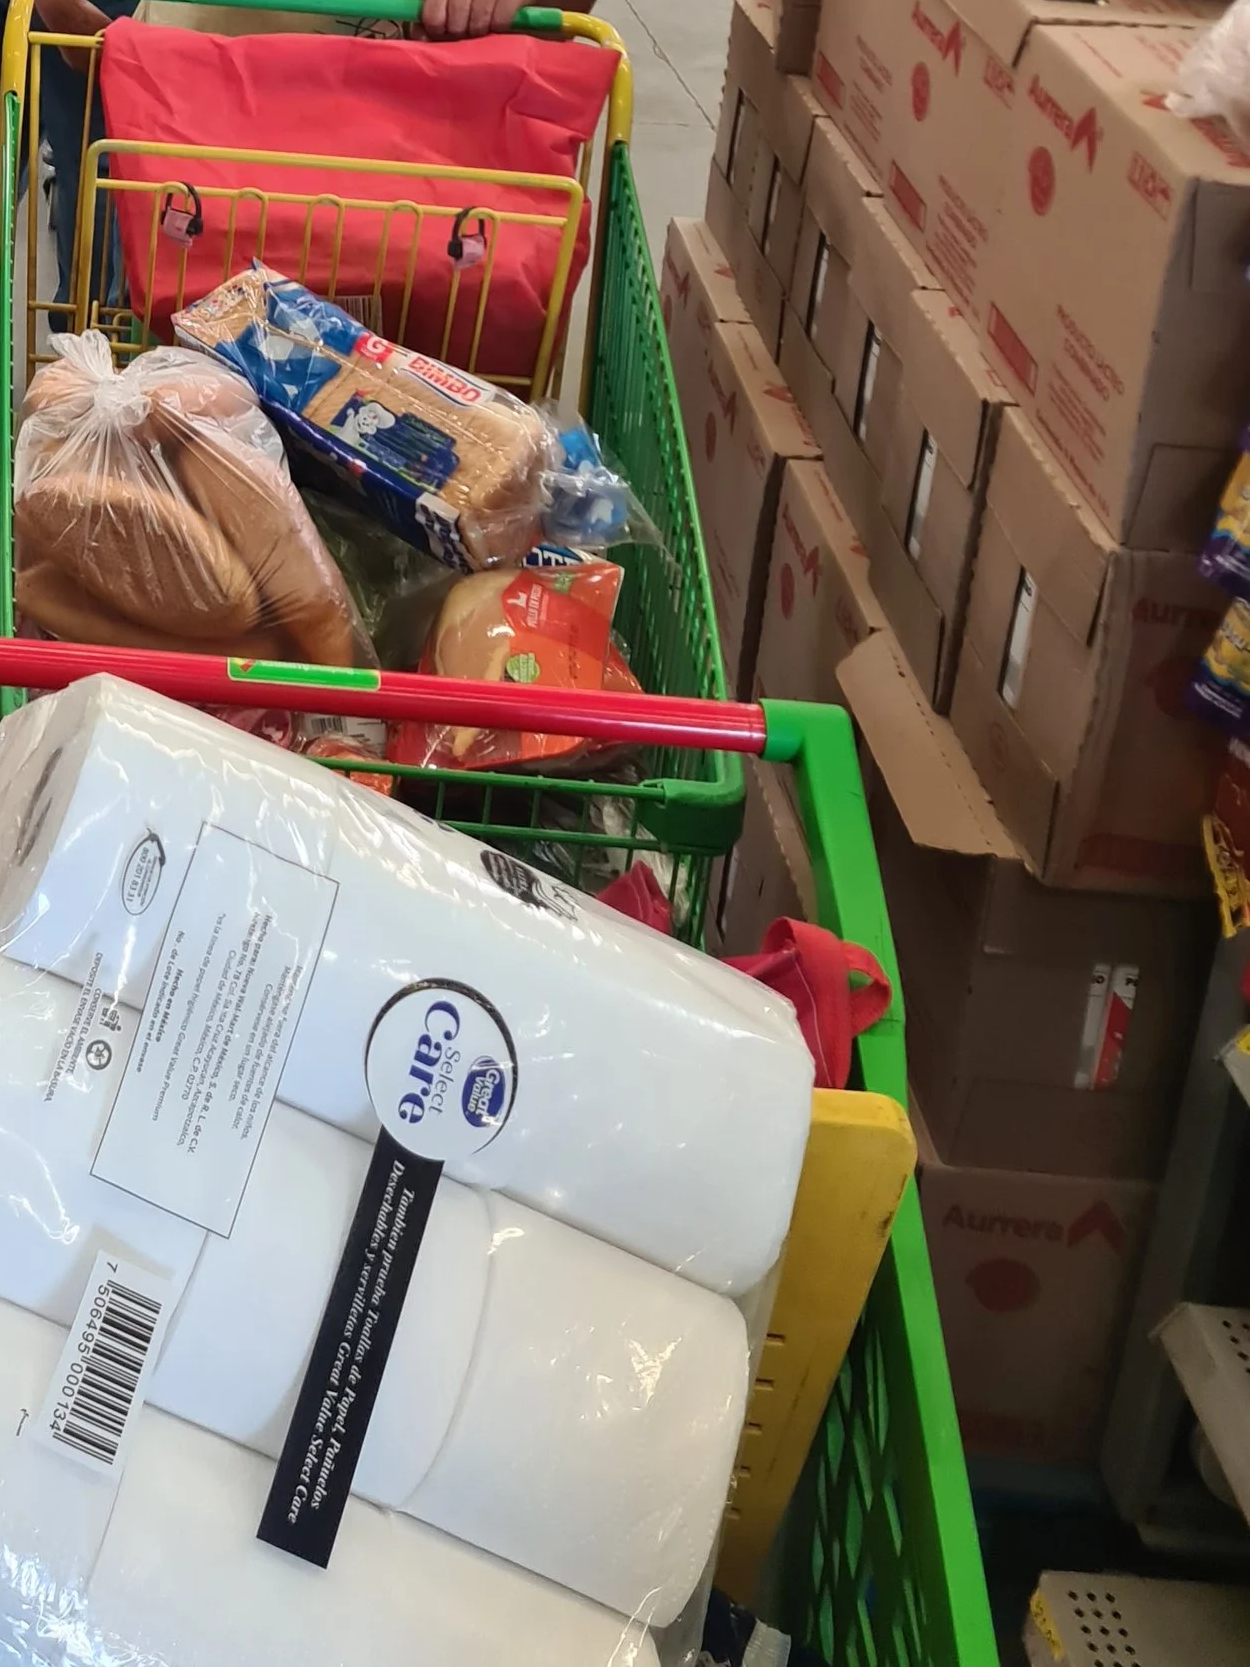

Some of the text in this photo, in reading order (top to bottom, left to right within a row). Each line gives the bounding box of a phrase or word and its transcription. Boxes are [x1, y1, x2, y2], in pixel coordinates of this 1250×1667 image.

[408, 356, 481, 402] BIMBO
[153, 968, 184, 1043] Hecho en México
[394, 996, 466, 1129] Care
[426, 1045, 462, 1118] Select
[150, 1080, 171, 1122] Premium
[465, 1075, 486, 1113] Value
[473, 1067, 501, 1118] Great
[368, 1159, 406, 1251] Desechables
[341, 1262, 376, 1340] servilletas
[47, 1259, 119, 1433] 7 506495 000134
[308, 1186, 416, 1511] Tambien prueba Toallas de Papel, Pañuelos
[327, 1340, 352, 1387] Great
[313, 1388, 338, 1433] Value
[297, 1433, 325, 1484] Select
[284, 1483, 309, 1526] Care
